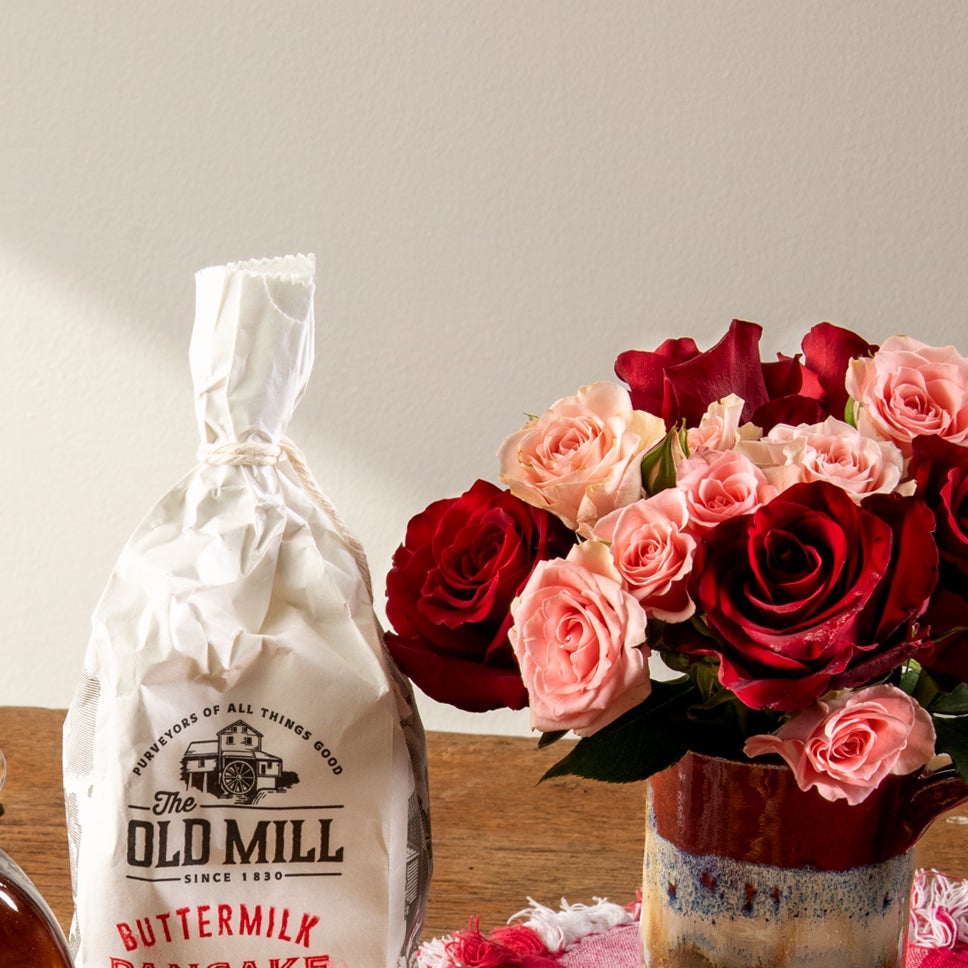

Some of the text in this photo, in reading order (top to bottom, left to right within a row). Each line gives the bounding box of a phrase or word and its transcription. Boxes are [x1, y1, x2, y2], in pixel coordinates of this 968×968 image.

[133, 703, 343, 775] PURVEYORS OF ALL THINGS GOOD
[152, 791, 197, 815] The
[127, 819, 344, 868] OLD MILL
[185, 872, 282, 883] SINCE 1830
[116, 904, 320, 952] BUTTERMILK
